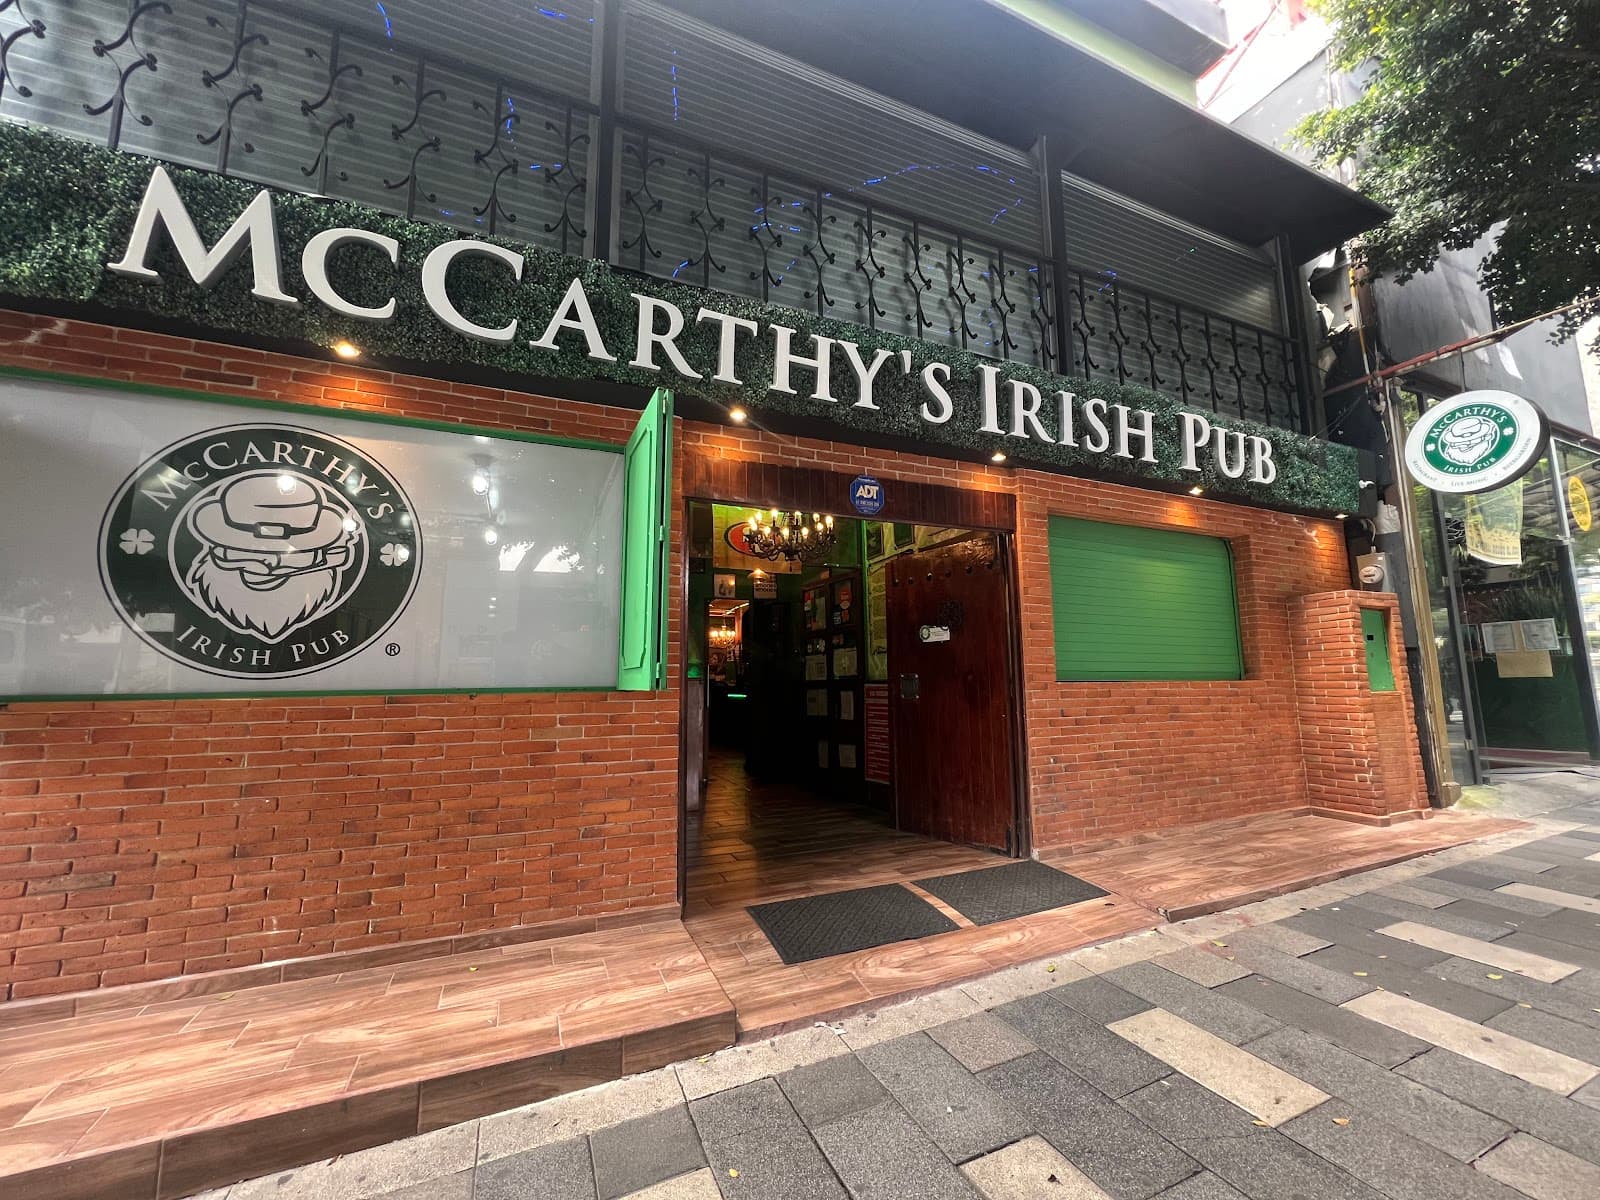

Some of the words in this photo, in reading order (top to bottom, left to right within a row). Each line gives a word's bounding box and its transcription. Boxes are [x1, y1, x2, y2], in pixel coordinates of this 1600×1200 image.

[974, 362, 1159, 464] IRISH
[1178, 410, 1278, 484] PUB
[1443, 464, 1472, 474] IRISH
[1477, 456, 1497, 470] PUB
[855, 484, 880, 500] ADT
[175, 624, 272, 666] IRISH
[291, 629, 350, 663] PUB
